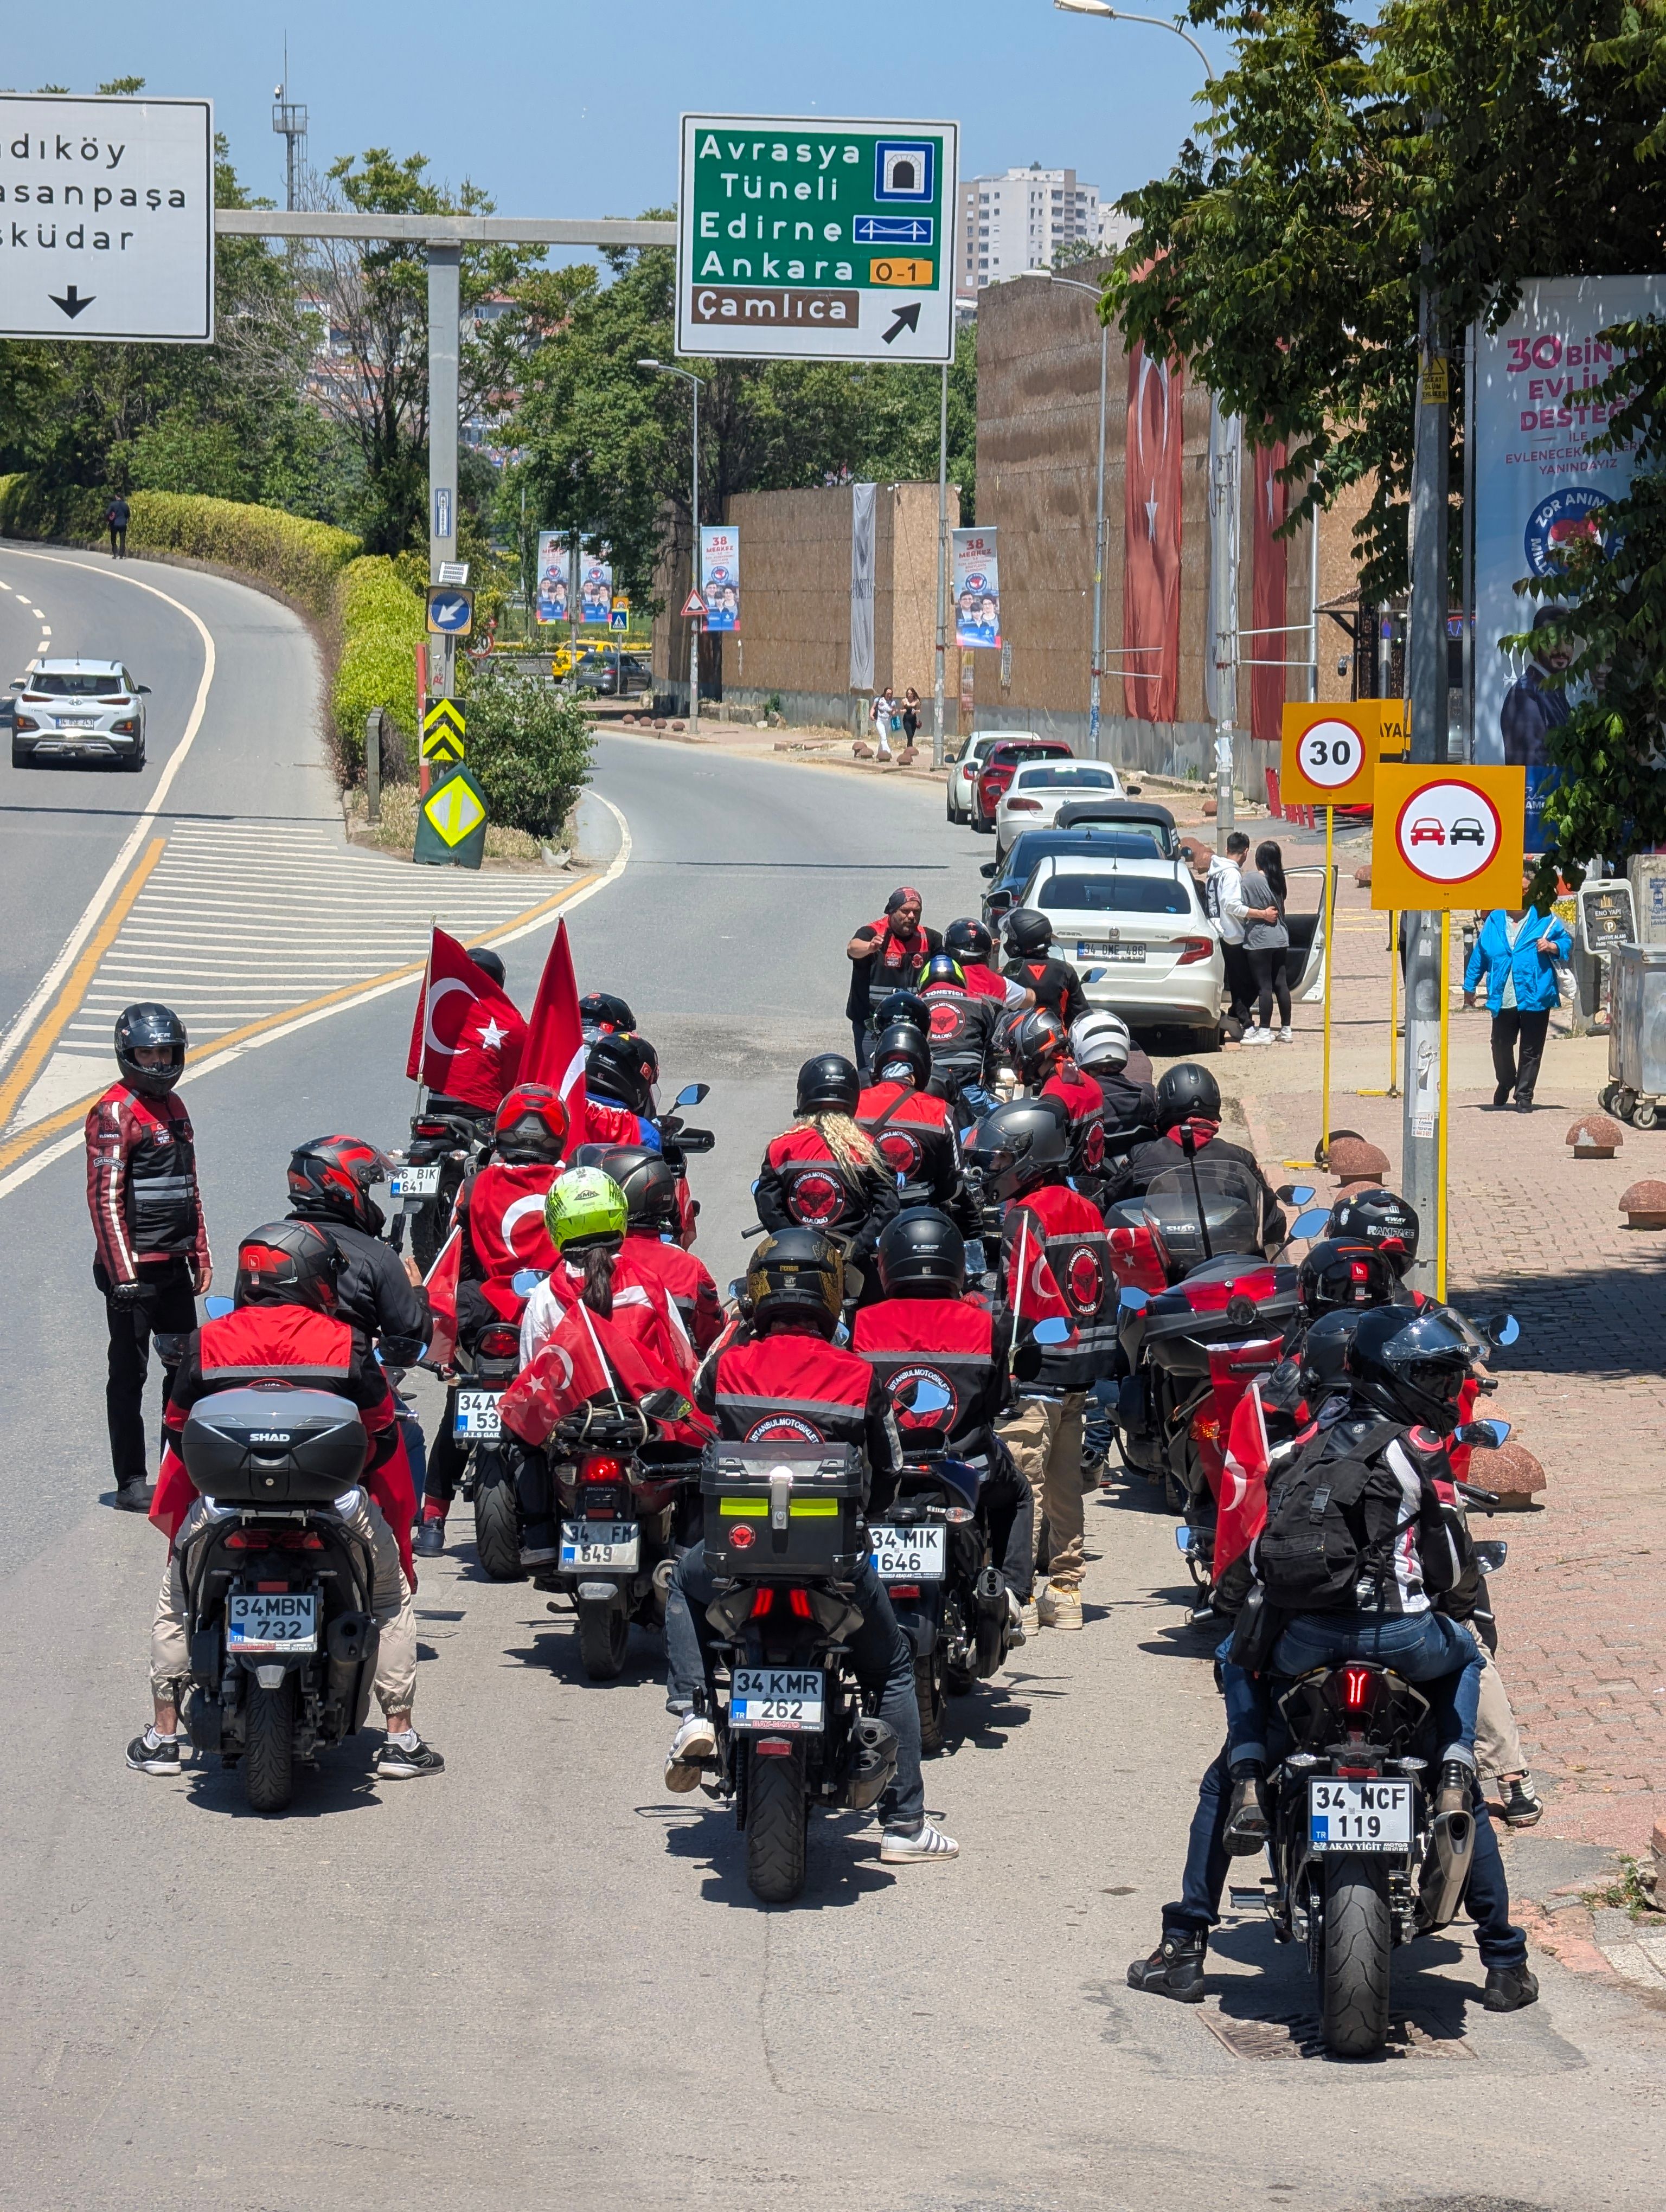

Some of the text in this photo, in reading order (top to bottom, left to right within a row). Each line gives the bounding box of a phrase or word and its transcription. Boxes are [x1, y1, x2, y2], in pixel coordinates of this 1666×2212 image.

[0, 133, 126, 169] dıköy
[699, 134, 860, 170] Avrasya
[721, 172, 837, 201] Tüneli
[0, 221, 134, 250] küdar
[700, 211, 843, 242] Edirne
[700, 250, 853, 281] Ankara
[697, 291, 846, 320] Çamlıca
[1507, 335, 1562, 372] 30
[1567, 337, 1612, 367] BİN
[1521, 393, 1637, 432] DESTEĞ
[1569, 430, 1588, 442] İLE
[1505, 446, 1582, 464] EVLENECEK
[1539, 458, 1618, 475] YANINDAYIZ
[1535, 499, 1562, 528] ZOR
[713, 536, 727, 546] 38
[966, 538, 984, 550] 38
[959, 548, 992, 558] MERKEZ
[1309, 741, 1351, 766] 30
[1085, 944, 1095, 954] 34
[1126, 946, 1143, 956] 486
[416, 1168, 437, 1179] BIK
[402, 1181, 423, 1192] 641
[576, 1190, 596, 1199] SMK
[1367, 1225, 1415, 1239] RAMPAGE
[460, 1394, 482, 1411] 34
[477, 1412, 499, 1430] 53
[249, 1433, 291, 1442] SHAD
[569, 1526, 588, 1542] 34
[872, 1530, 938, 1549] 34 MIK
[882, 1552, 921, 1572] 646
[257, 1621, 302, 1640] 732
[737, 1672, 818, 1695] 34 KMR
[761, 1697, 803, 1720] 262
[1316, 1785, 1406, 1810] 34 NCF
[1316, 1831, 1327, 1839] TR
[1338, 1814, 1381, 1838] 119
[1329, 1841, 1382, 1851] AKAY YİĞİT
